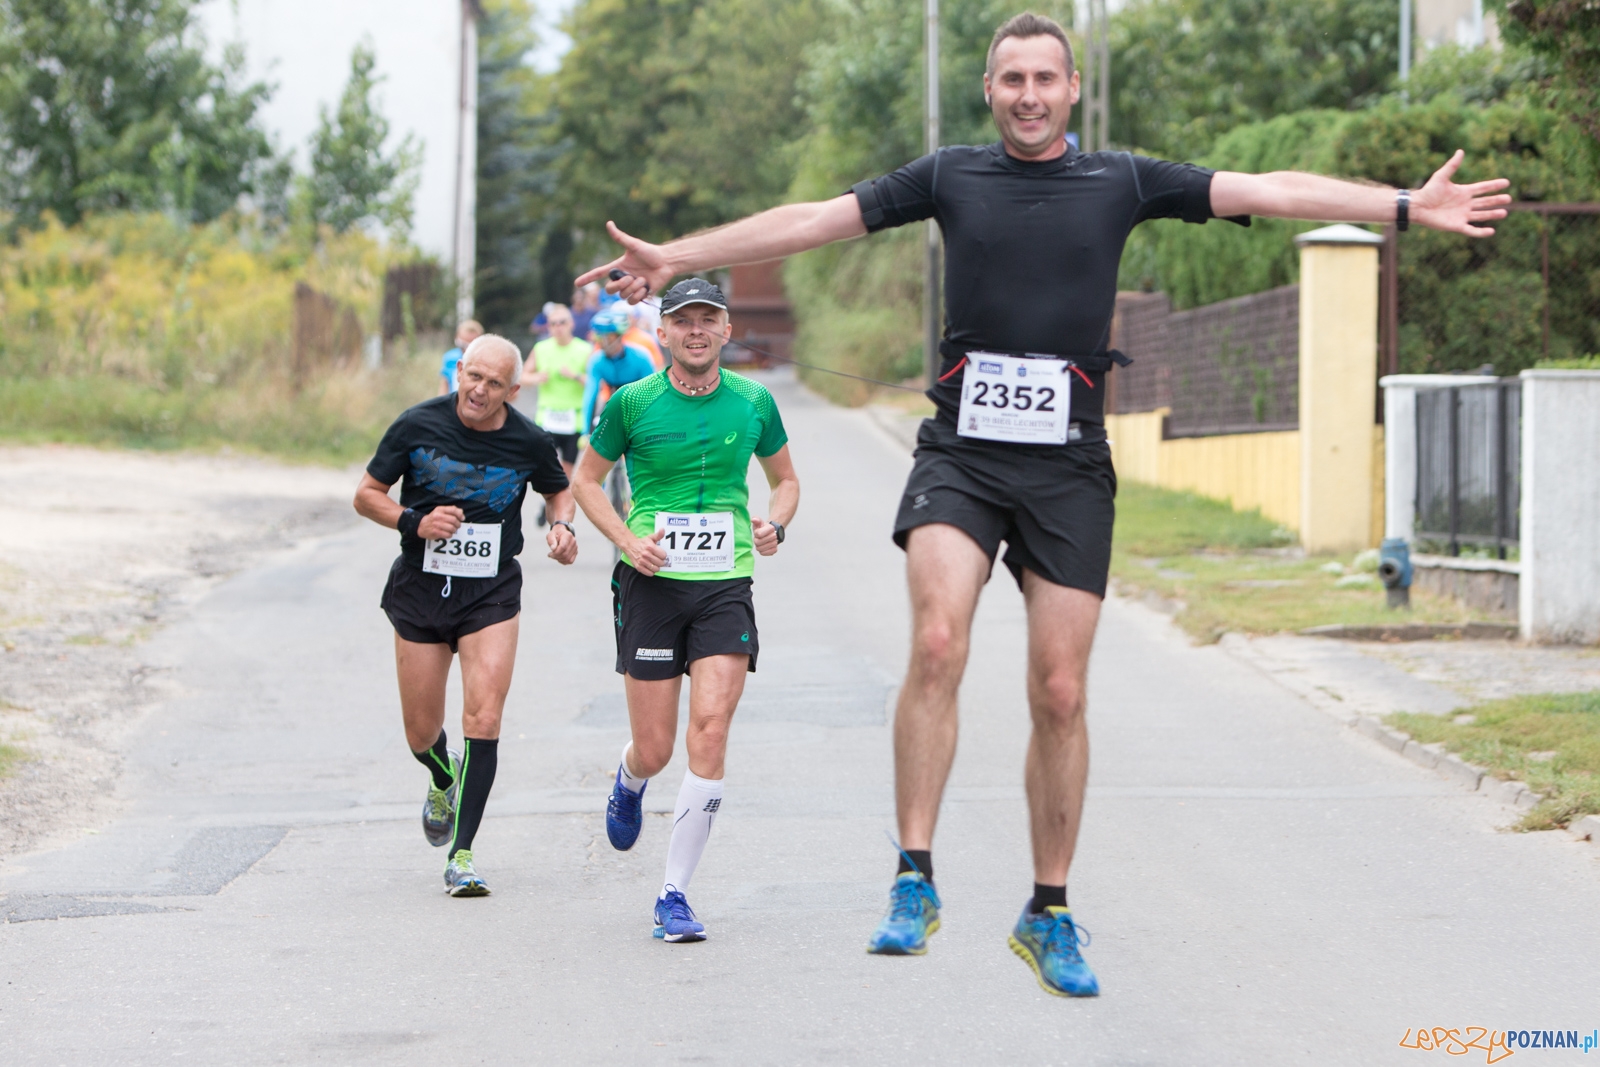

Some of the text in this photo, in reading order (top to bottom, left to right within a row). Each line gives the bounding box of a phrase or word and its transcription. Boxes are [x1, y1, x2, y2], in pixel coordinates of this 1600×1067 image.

[972, 381, 1055, 411] 2352
[433, 538, 491, 558] 2368
[665, 531, 726, 550] 1727
